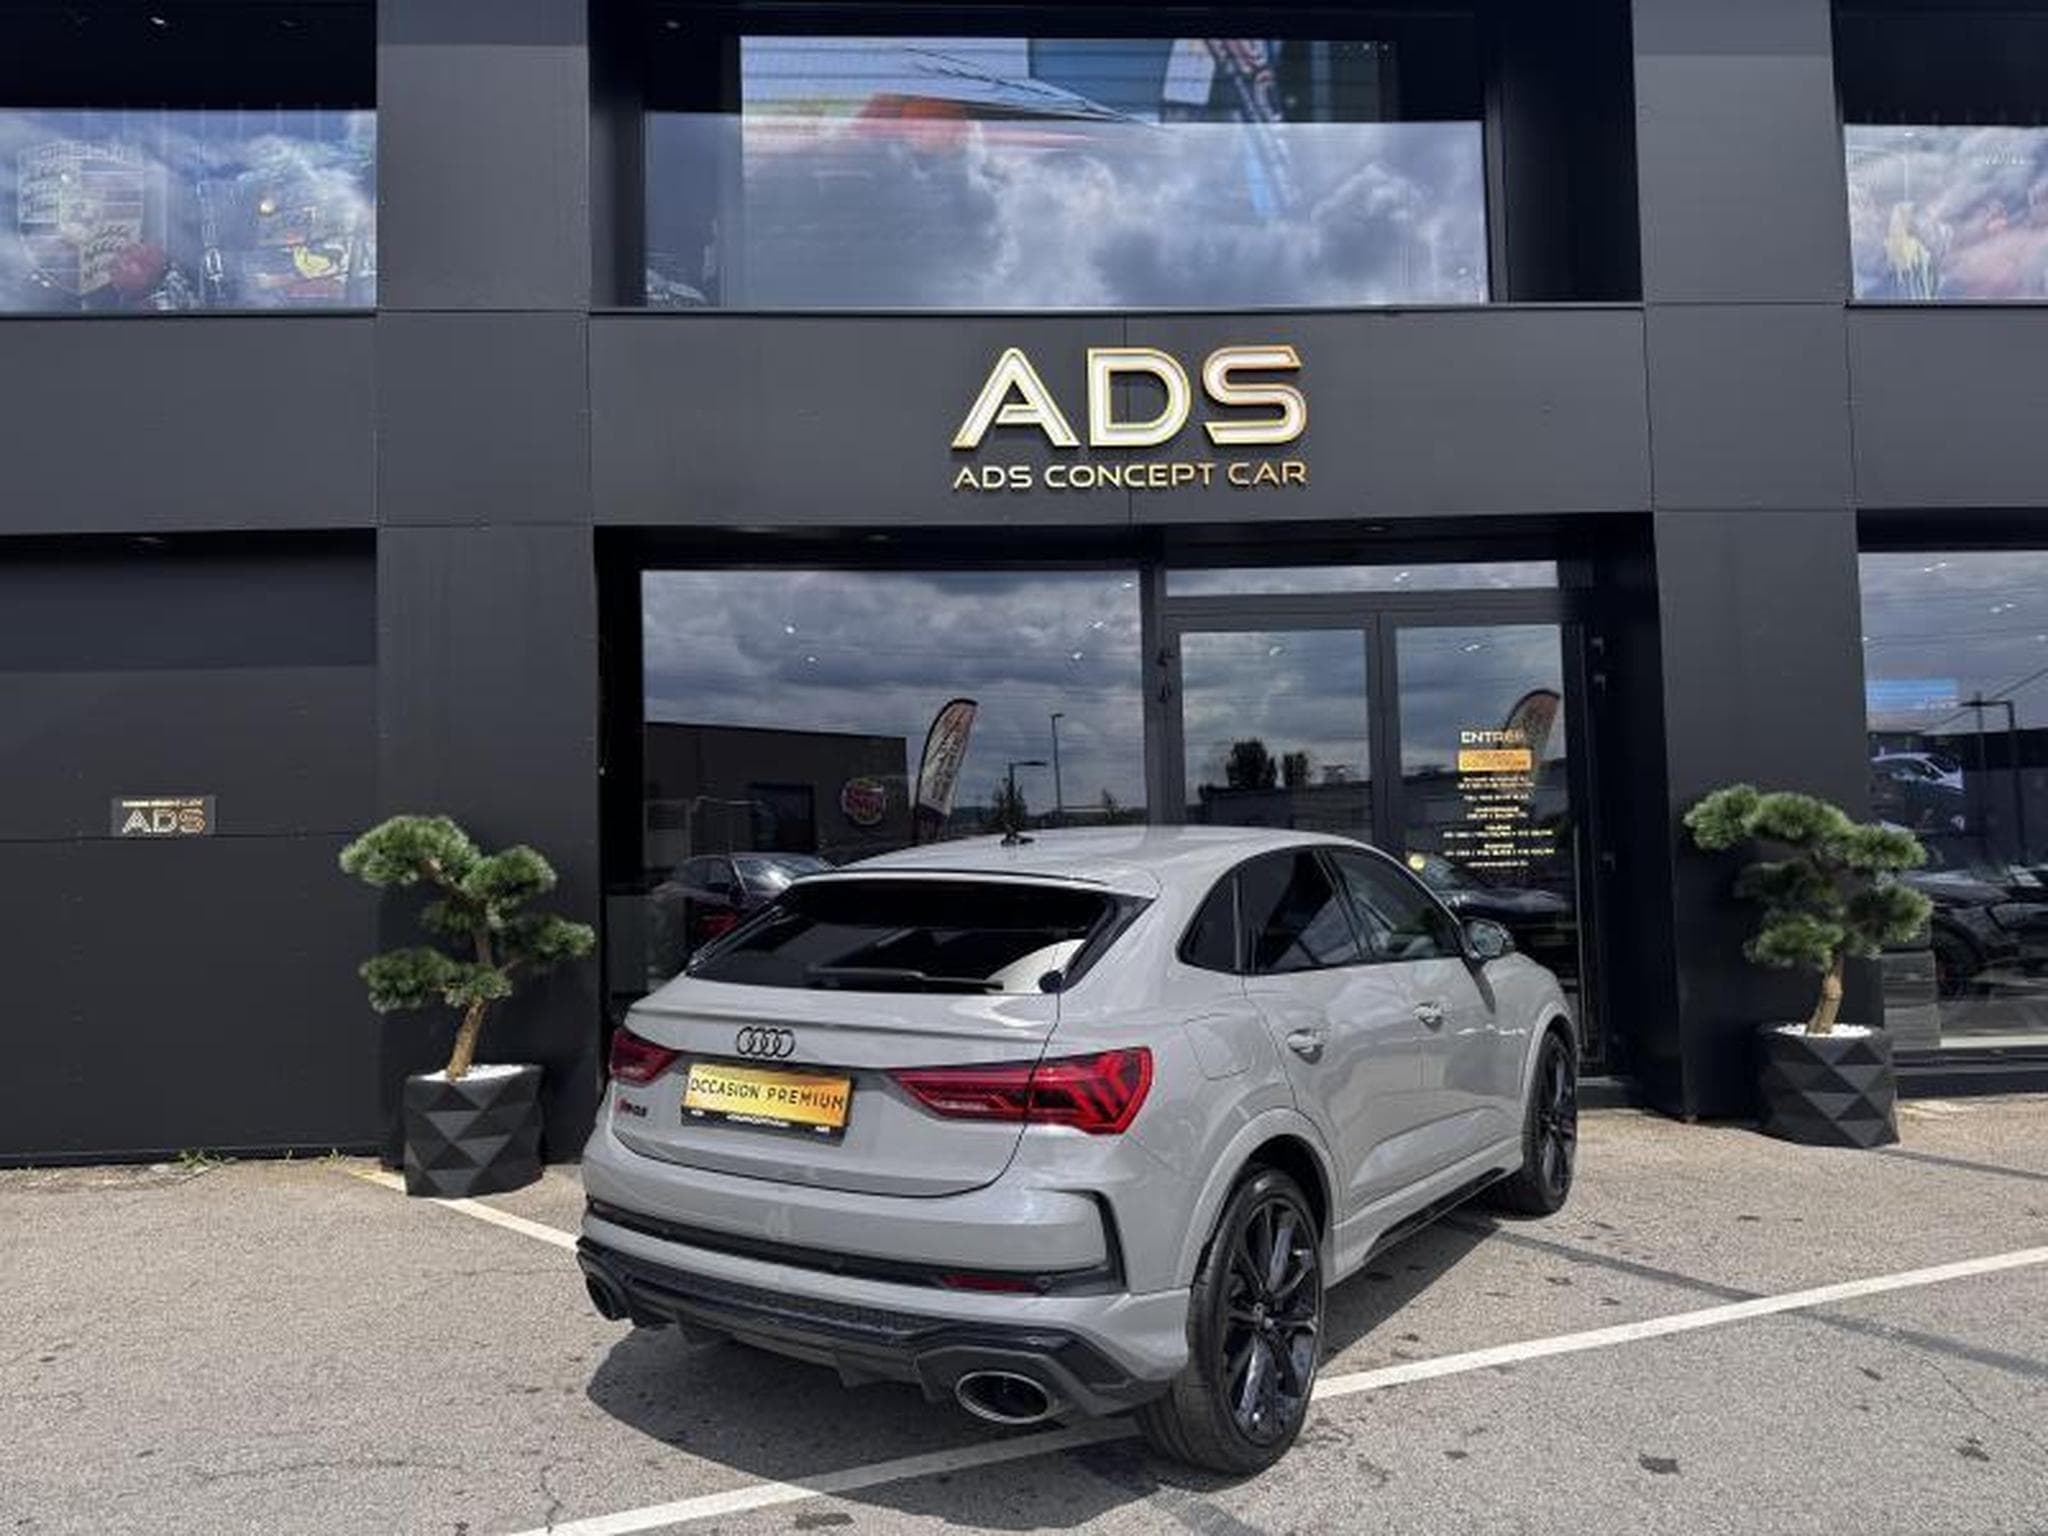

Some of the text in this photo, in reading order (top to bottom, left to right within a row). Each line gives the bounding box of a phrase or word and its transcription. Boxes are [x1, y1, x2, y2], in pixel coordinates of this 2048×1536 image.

[951, 345, 1308, 449] ADS
[953, 462, 1308, 490] ADS CONCEPT CAR
[121, 809, 206, 834] ADS
[689, 1078, 845, 1111] OCCASION PREMIUM
